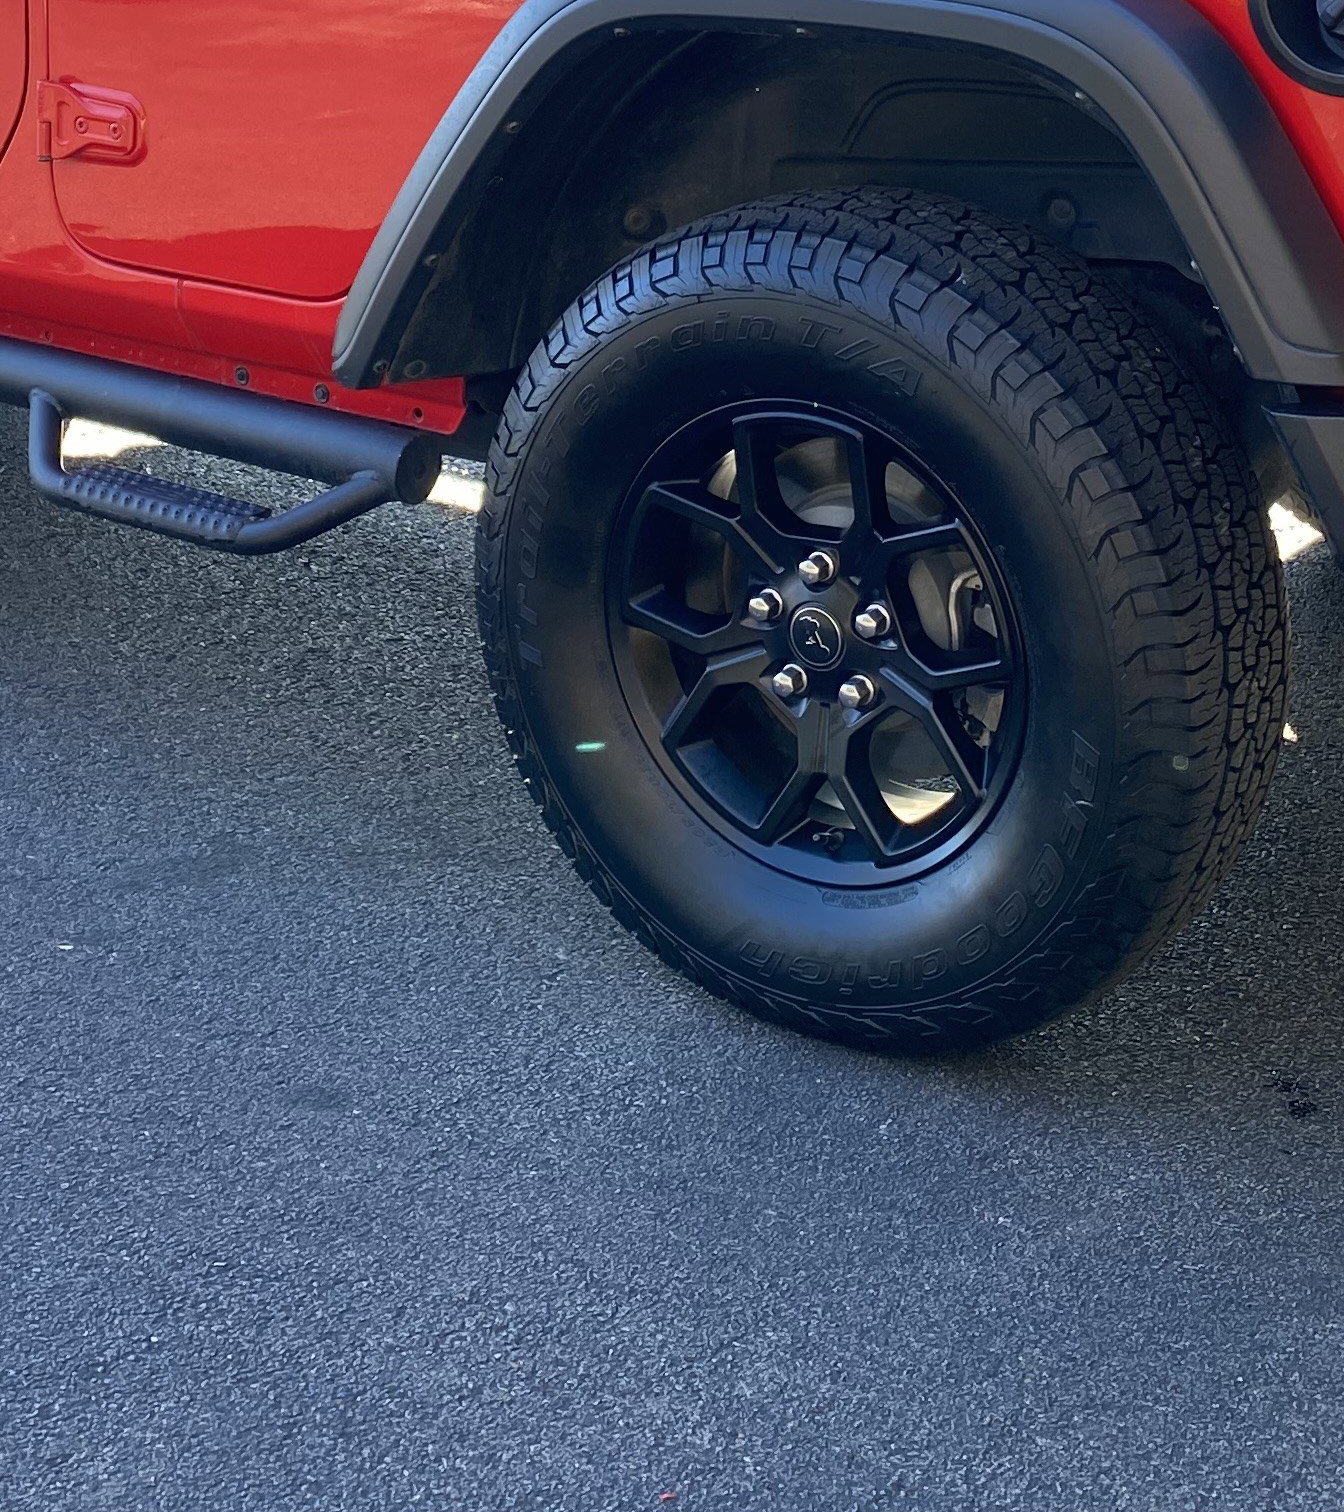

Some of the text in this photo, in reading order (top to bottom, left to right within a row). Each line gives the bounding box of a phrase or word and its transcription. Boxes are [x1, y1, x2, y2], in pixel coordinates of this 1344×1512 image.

[514, 313, 927, 670] Trail-Terrain T/A
[738, 729, 1101, 995] BFGoodrich
